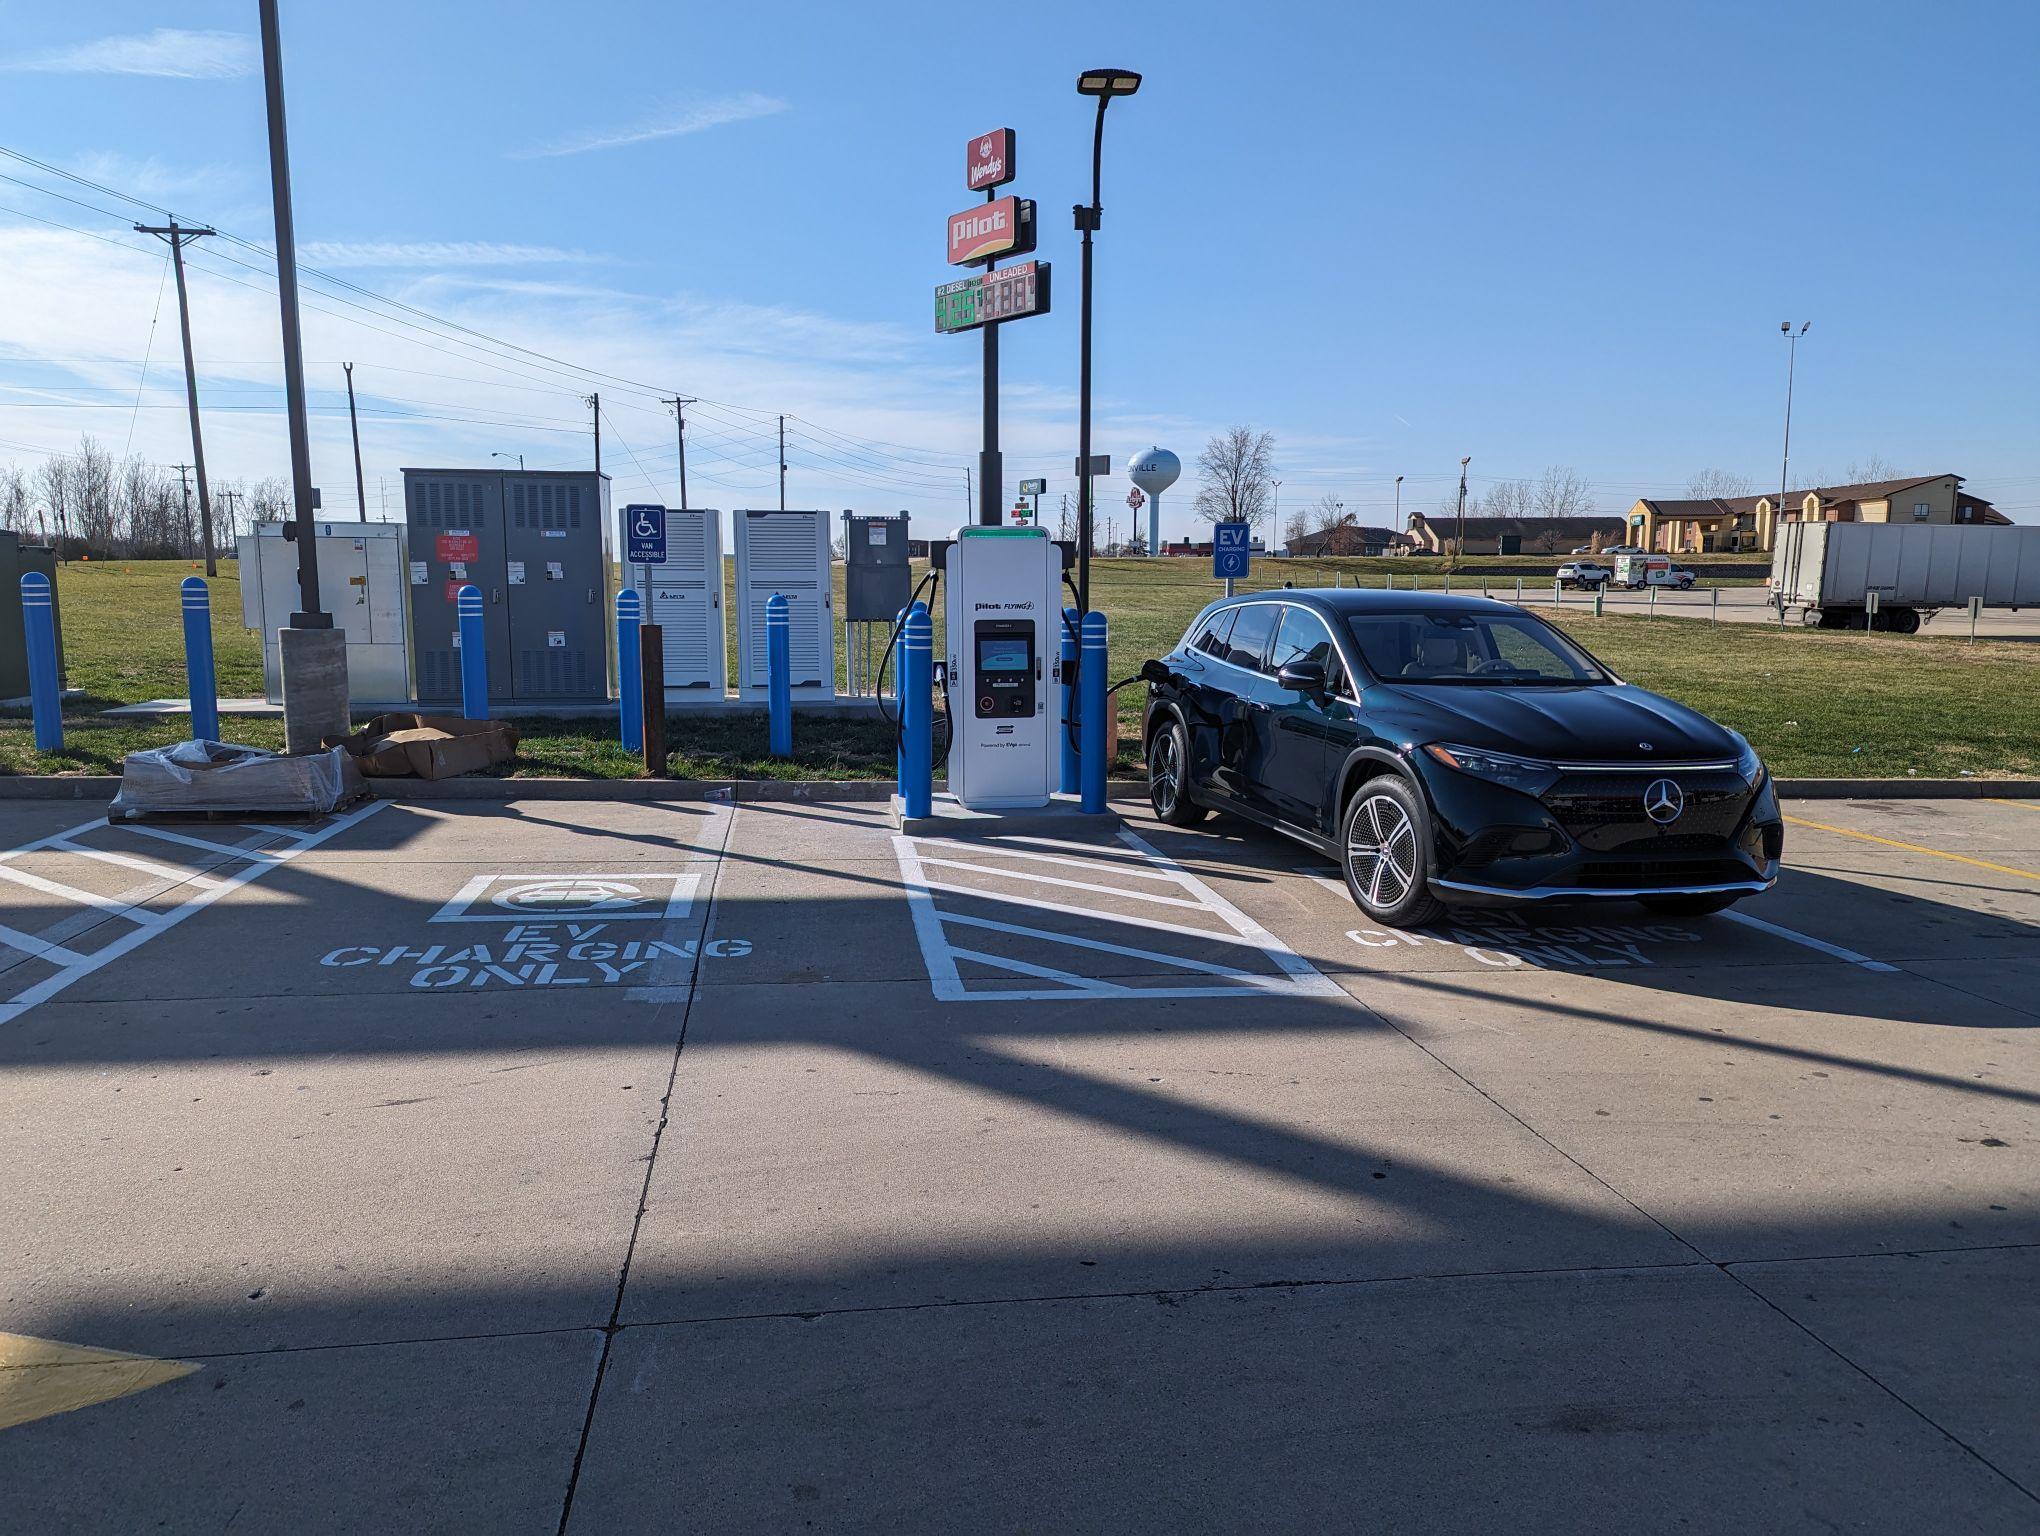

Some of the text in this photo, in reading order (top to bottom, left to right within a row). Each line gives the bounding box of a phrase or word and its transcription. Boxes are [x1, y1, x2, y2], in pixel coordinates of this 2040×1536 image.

[971, 156, 1002, 185] Wendy's
[989, 265, 1028, 283] UNLEADED
[946, 281, 966, 294] DIESEL
[1220, 529, 1244, 545] EV
[630, 551, 665, 559] ACCESSIBLE
[503, 923, 609, 942] EV
[1345, 926, 1703, 948] CHARGING
[319, 938, 754, 967] CHARGING
[1463, 944, 1655, 968] ONLY
[409, 960, 647, 988] ONLY
